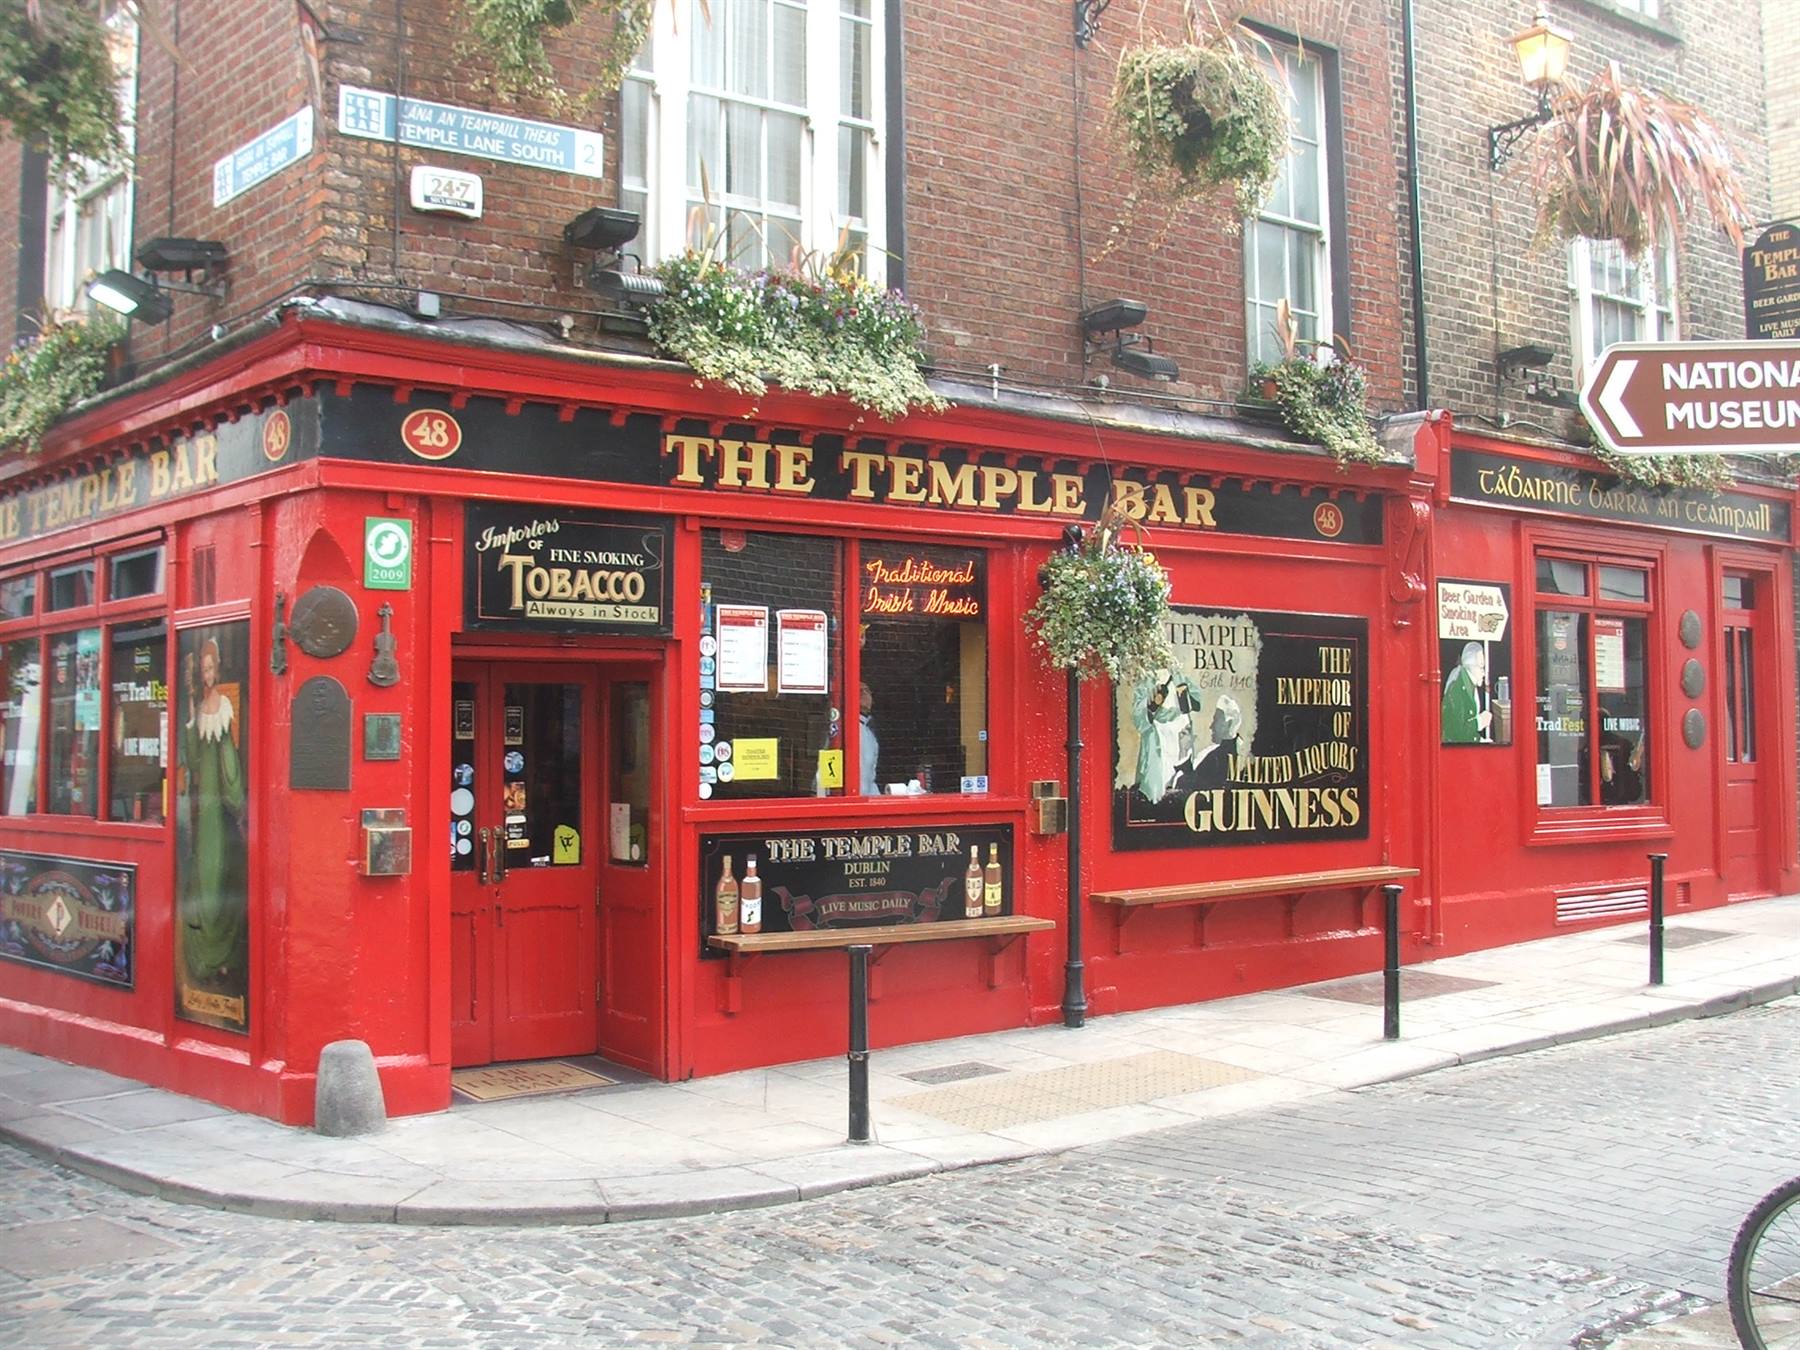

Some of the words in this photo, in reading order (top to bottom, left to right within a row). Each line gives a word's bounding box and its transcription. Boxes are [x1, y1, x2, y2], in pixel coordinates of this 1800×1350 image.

[436, 110, 457, 127] AN
[460, 113, 519, 139] TEAMPAILL
[523, 126, 561, 146] THEAS
[398, 122, 458, 146] TEMPLE
[464, 133, 505, 155] LANE
[511, 142, 565, 165] SOUTH
[583, 144, 596, 164] 2
[1769, 230, 1791, 243] THE
[1765, 264, 1797, 281] BAR
[1753, 297, 1775, 309] BEER
[1760, 322, 1779, 333] LIVE
[1771, 328, 1796, 339] DAILY
[267, 420, 286, 451] 48
[412, 416, 449, 448] 48
[27, 461, 137, 531] TEMPLE
[150, 434, 219, 497] BAR
[664, 434, 816, 495] THE
[840, 451, 1088, 517] TEMPLE
[1111, 479, 1217, 527] BAR
[1318, 508, 1336, 530] 48
[475, 518, 560, 554] Importers
[528, 539, 545, 551] OF
[550, 549, 582, 563] FINE
[583, 551, 645, 567] SMOKING
[372, 569, 403, 580] 2009
[497, 553, 646, 610] TOBACCO
[866, 557, 974, 584] Traditional
[864, 586, 914, 613] Irish
[922, 588, 979, 616] Music
[1441, 587, 1460, 603] Beer
[1463, 589, 1493, 606] Garden
[529, 601, 585, 618] Always
[593, 605, 607, 618] in
[612, 605, 657, 621] Stock
[1441, 604, 1477, 624] Smoking
[1164, 622, 1256, 648] TEMPLE
[1449, 622, 1469, 636] Area
[1193, 648, 1236, 674] BAR
[1318, 646, 1352, 674] THE
[1276, 677, 1352, 707] EMPEROR
[1332, 711, 1352, 738] OF
[1535, 716, 1585, 732] TradFest
[1603, 717, 1618, 731] LIVE
[1619, 717, 1640, 731] MUSIC
[1226, 752, 1293, 785] MALTED
[1295, 740, 1359, 779] LIQUORS
[1183, 786, 1361, 833] GUINNESS
[765, 838, 817, 863] THE
[821, 834, 913, 861] TEMPLE
[917, 832, 963, 856] BAR
[844, 861, 891, 875] DUBLIN
[848, 878, 867, 888] EST.
[869, 877, 886, 887] 1840
[821, 901, 846, 915] LIVE
[848, 901, 880, 912] MUSIC
[881, 897, 913, 911] DAILY
